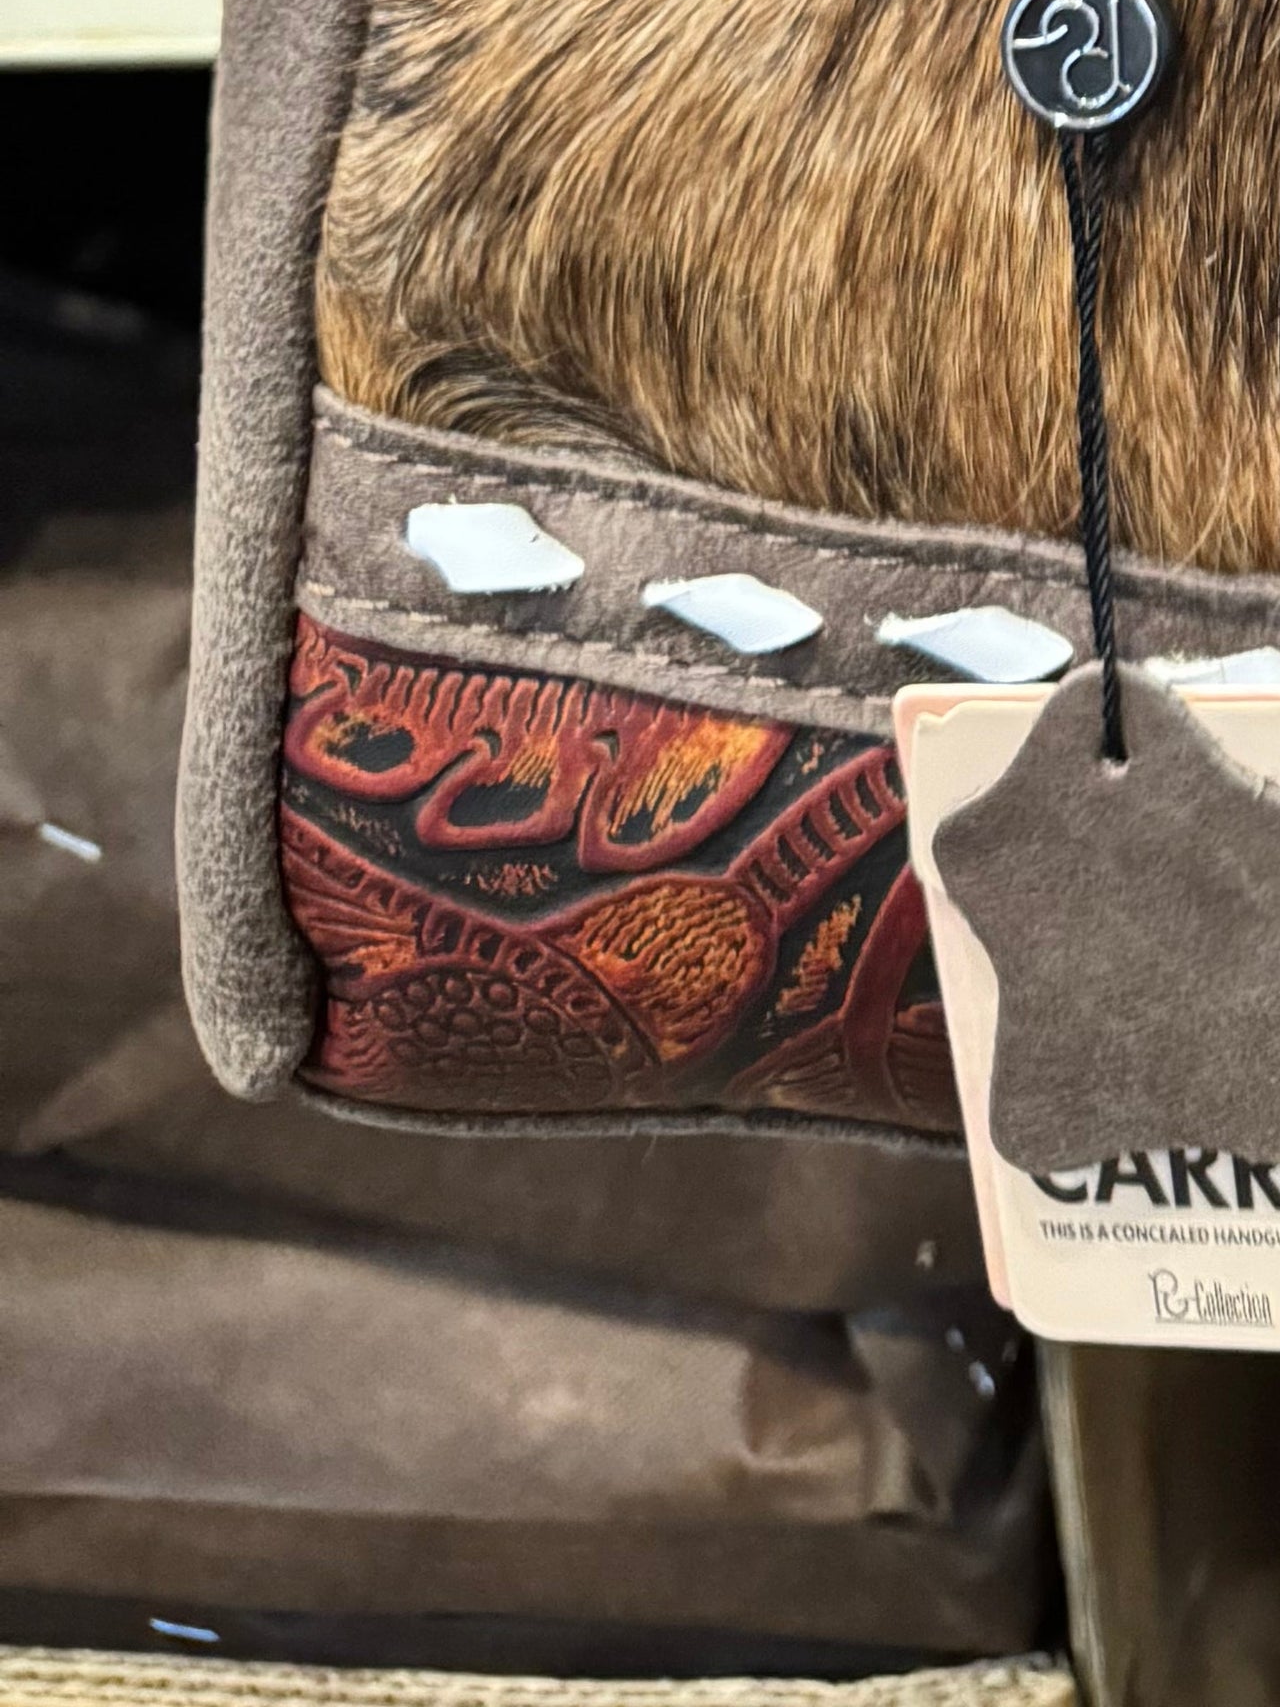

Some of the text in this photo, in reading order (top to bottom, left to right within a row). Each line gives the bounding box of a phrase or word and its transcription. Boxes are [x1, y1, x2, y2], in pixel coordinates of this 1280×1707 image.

[1039, 1219, 1077, 1241] THIS
[1079, 1221, 1094, 1241] IS
[1097, 1222, 1109, 1242] A
[1111, 1223, 1209, 1244] CONCEALED
